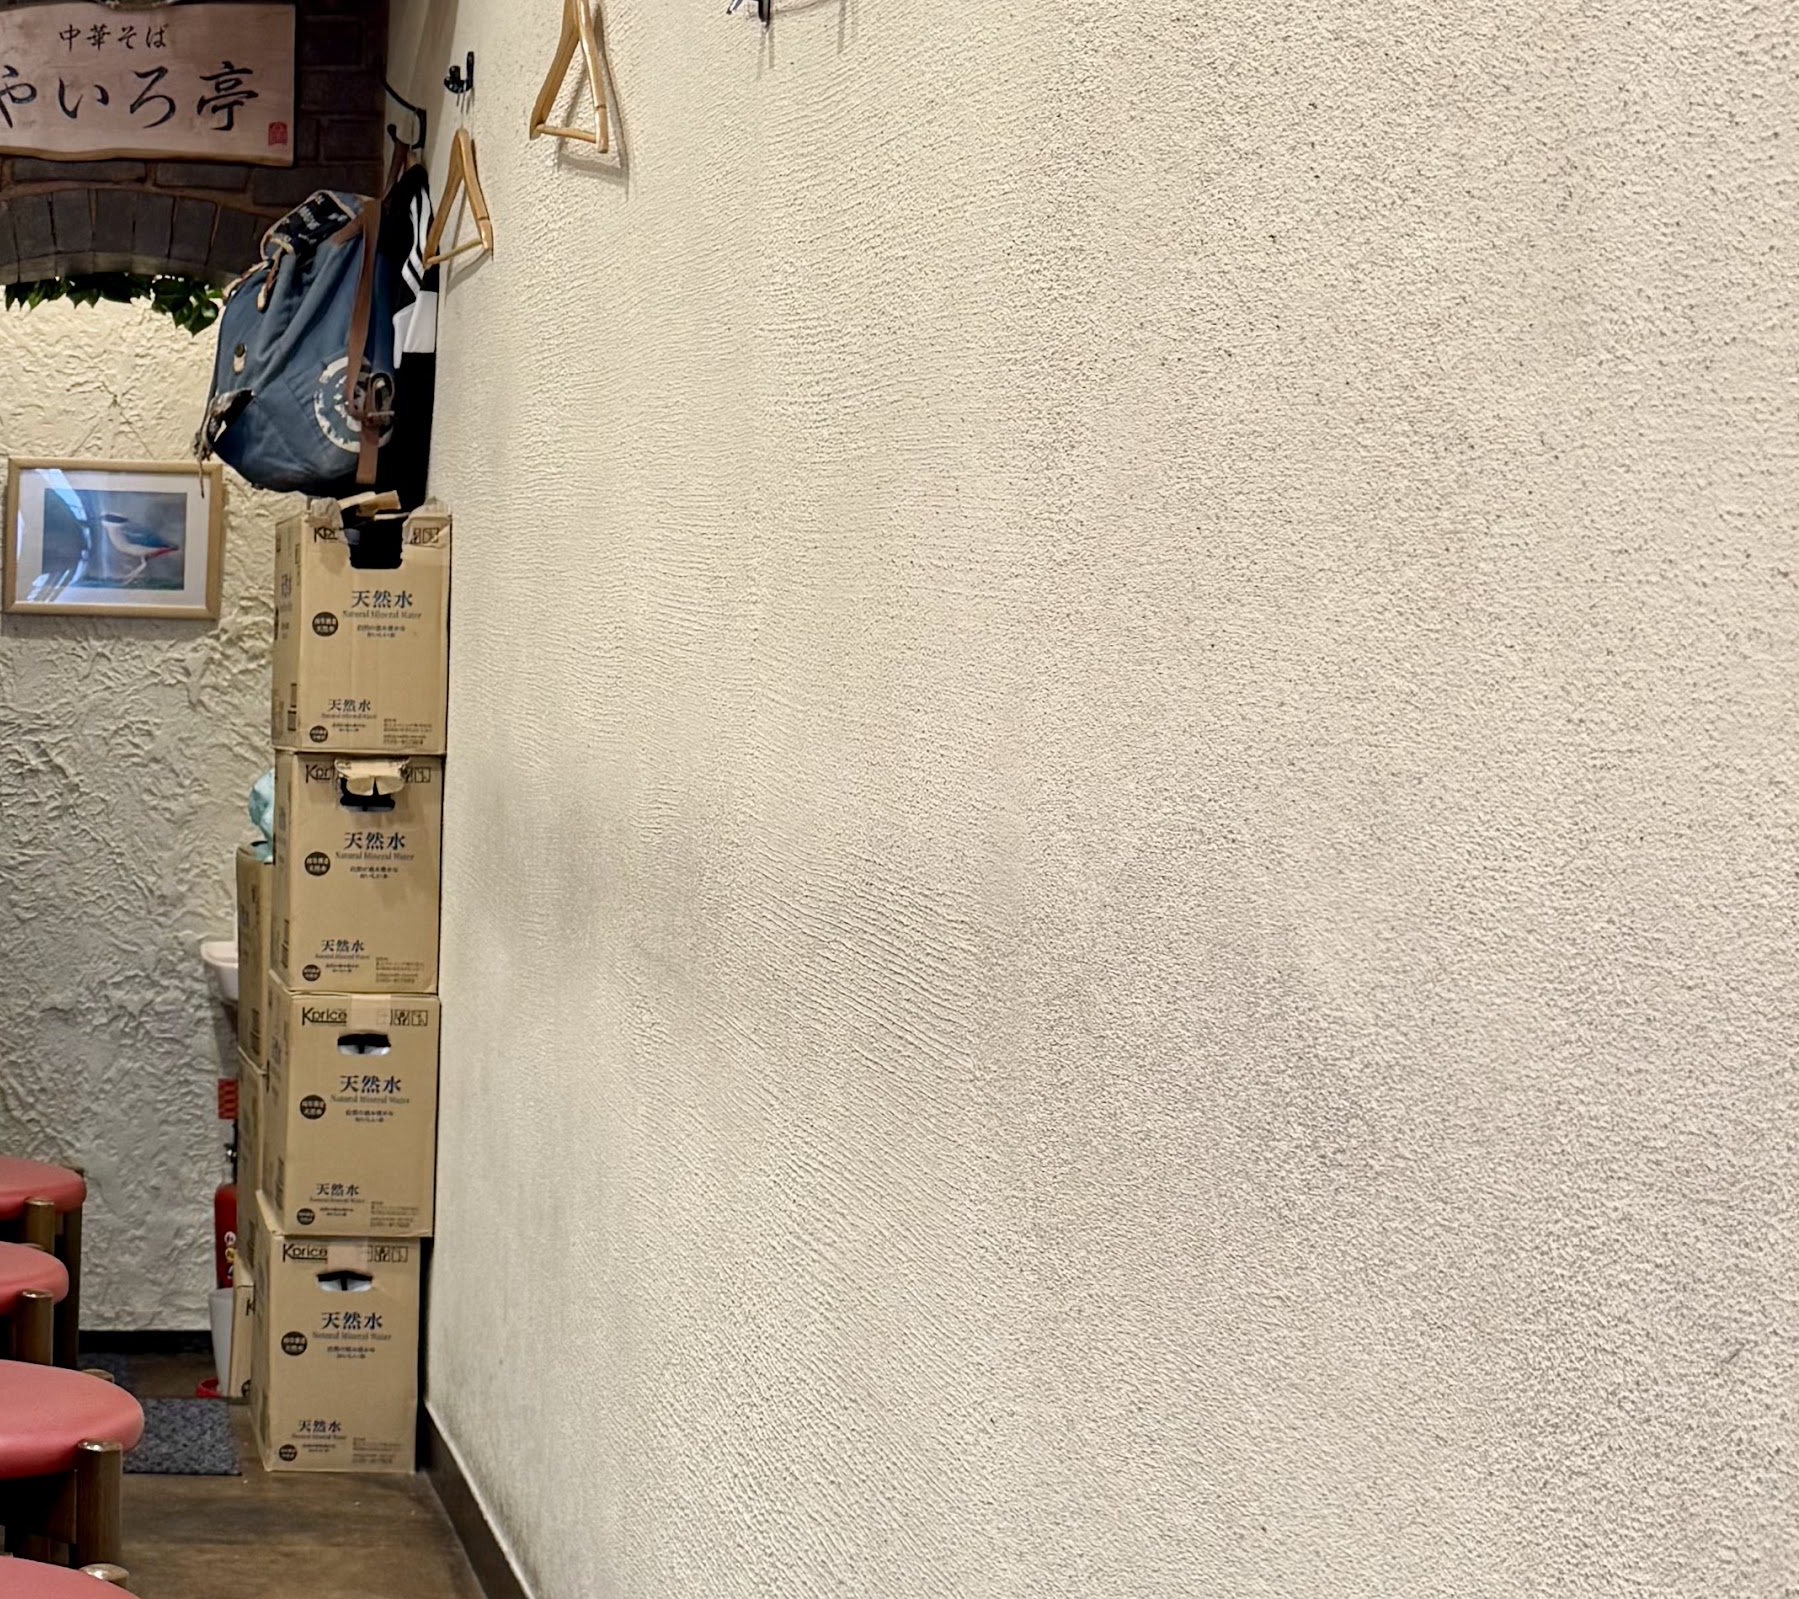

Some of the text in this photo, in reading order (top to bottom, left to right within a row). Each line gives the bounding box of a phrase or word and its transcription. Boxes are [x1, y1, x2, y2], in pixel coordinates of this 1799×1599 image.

[59, 24, 168, 50] 中華そば
[352, 590, 413, 608] 天然水
[328, 699, 371, 712] 天然水
[344, 831, 406, 850] 天然水
[321, 939, 365, 952] 天然水
[302, 1007, 347, 1026] Kprice
[340, 1075, 402, 1094] 天然水
[316, 1183, 360, 1196] 天然水
[282, 1244, 328, 1262] Kprice
[321, 1312, 382, 1330] 天然水
[299, 1420, 341, 1433] 天然水
